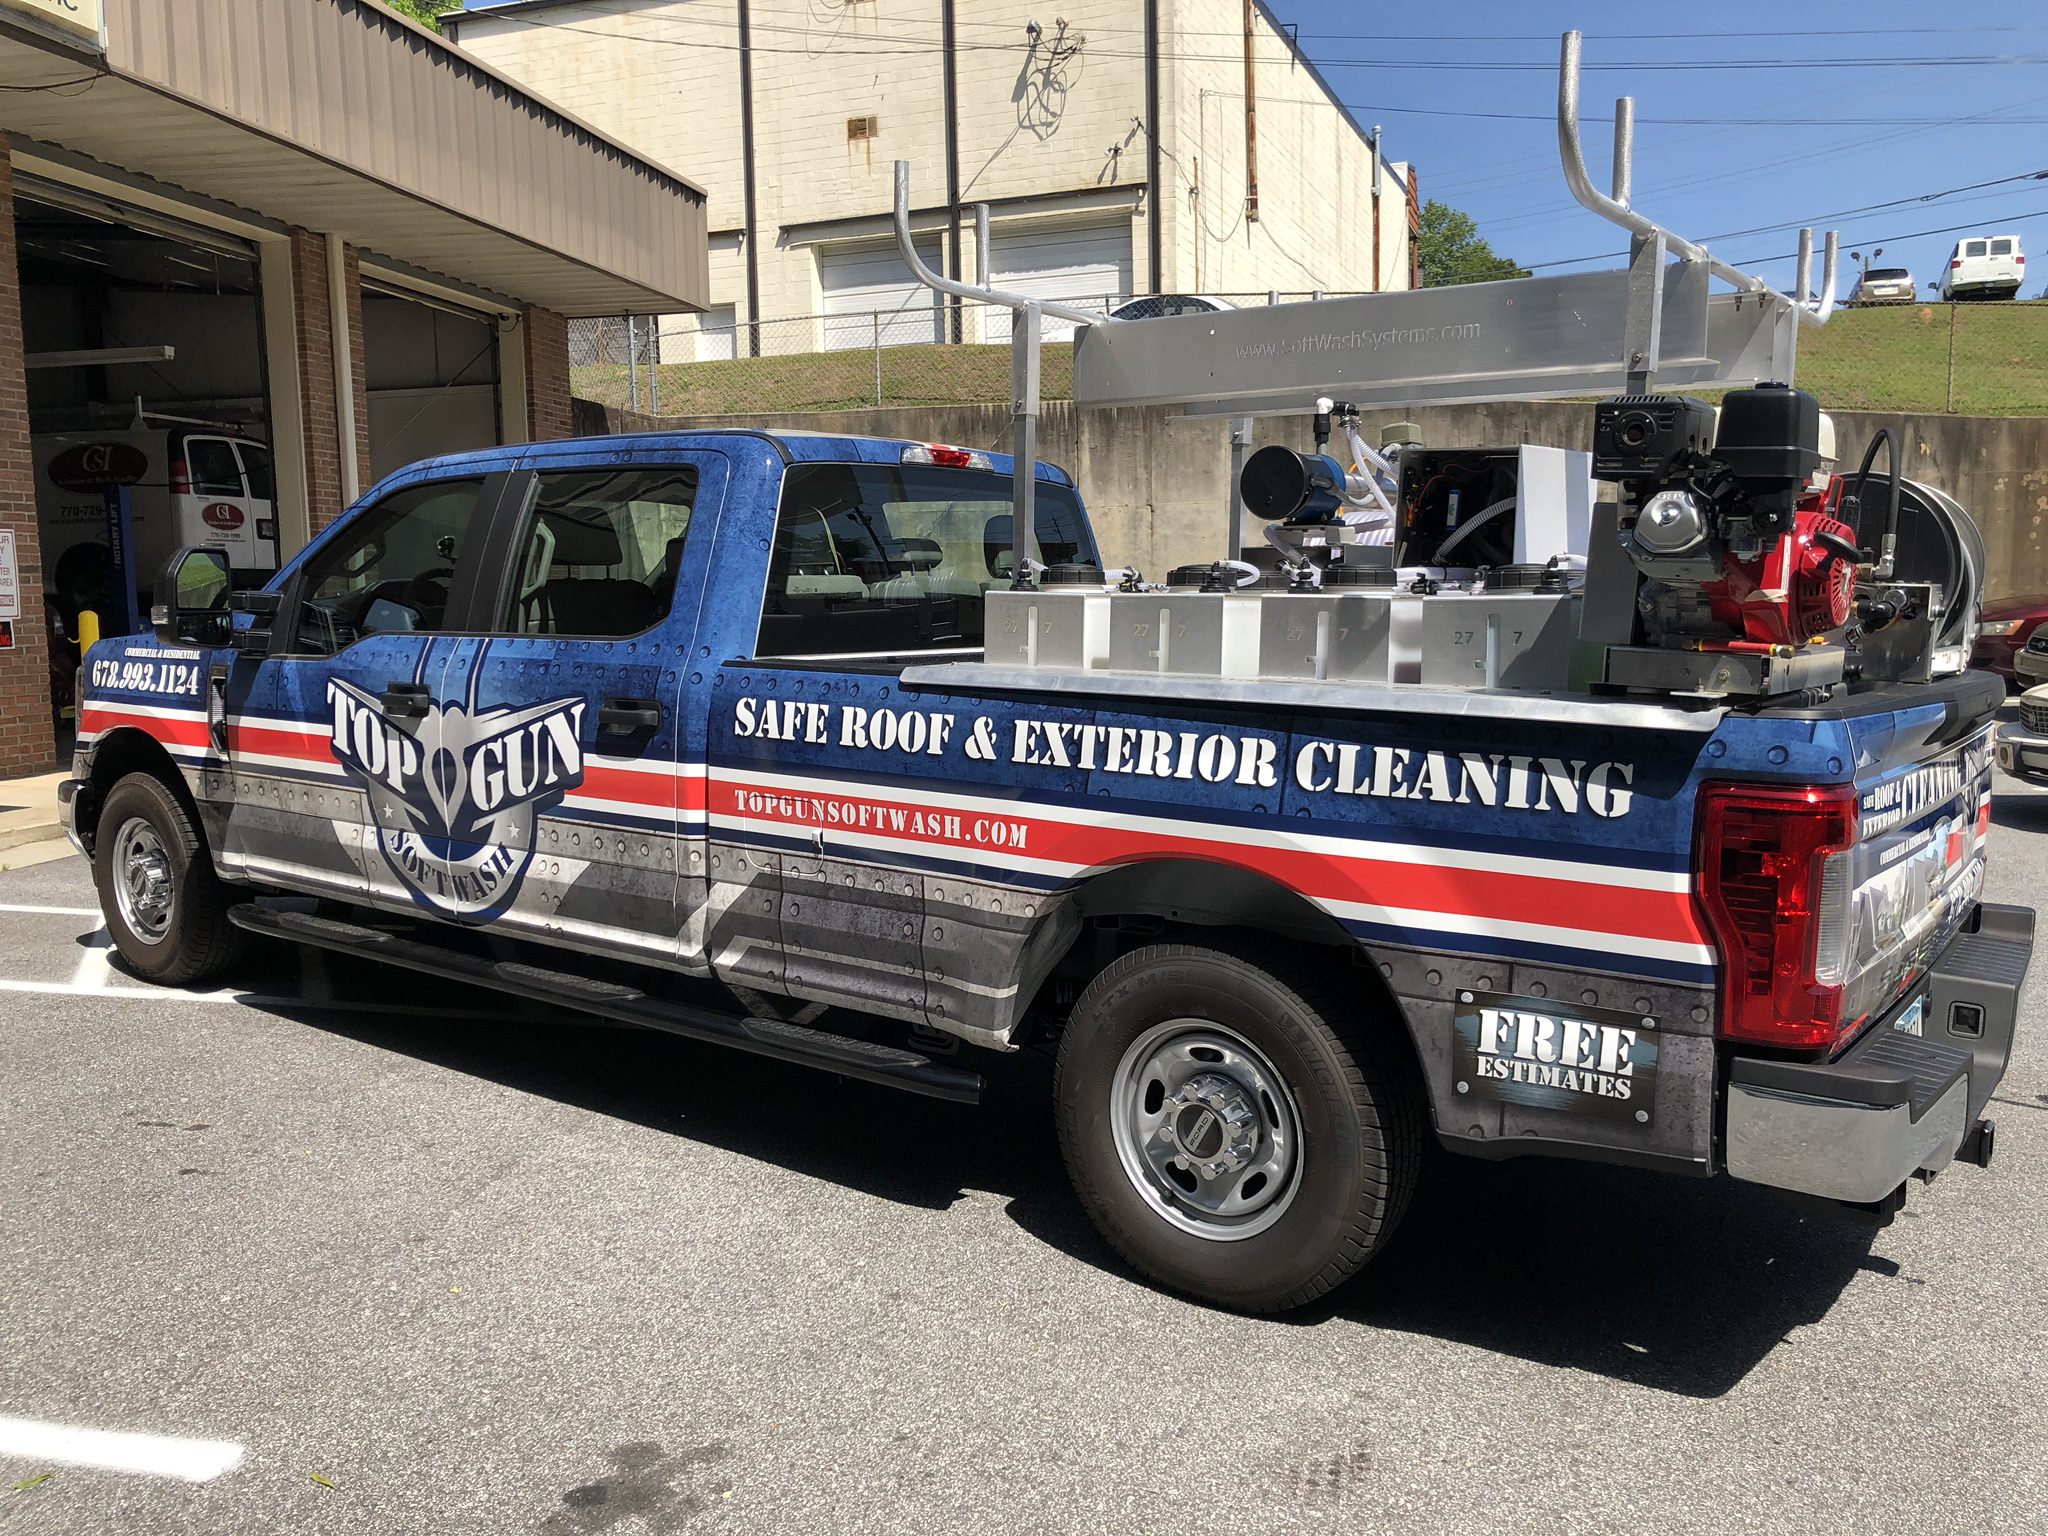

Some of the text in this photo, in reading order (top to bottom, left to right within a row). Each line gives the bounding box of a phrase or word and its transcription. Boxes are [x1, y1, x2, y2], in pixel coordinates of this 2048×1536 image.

[1236, 323, 1480, 360] www.SoftWashSystems.com
[1133, 623, 1187, 637] 27 7
[1339, 628, 1350, 641] 7
[1454, 631, 1523, 646] 27 7
[92, 660, 199, 695] 678.993.1124
[327, 682, 586, 811] TOP GUN
[734, 697, 1634, 818] SAFE ROOF & EXTERIOR CLEANING
[1874, 783, 1895, 811] ROOF
[734, 790, 1028, 849] TOPGUNSOFTWASH.COM
[1476, 1008, 1636, 1076] FREE
[1476, 1055, 1632, 1100] ESTIMATES
[1189, 1116, 1209, 1147] FORD
